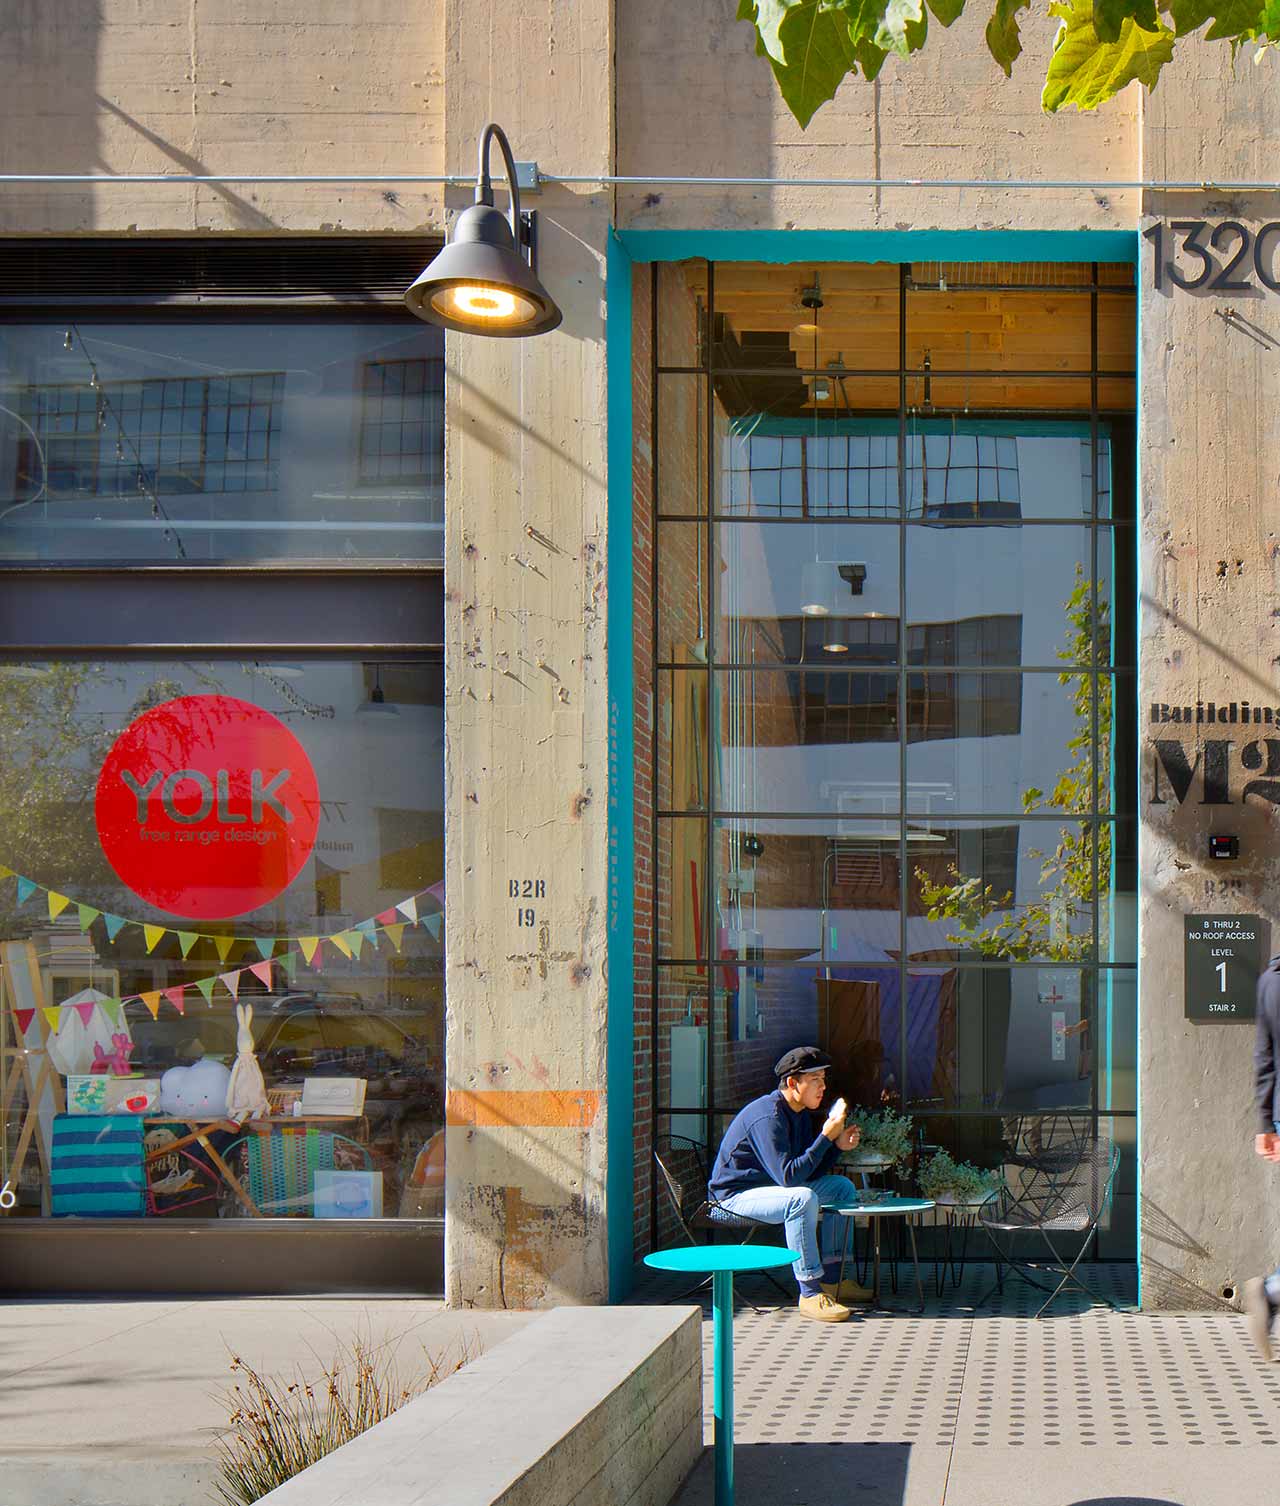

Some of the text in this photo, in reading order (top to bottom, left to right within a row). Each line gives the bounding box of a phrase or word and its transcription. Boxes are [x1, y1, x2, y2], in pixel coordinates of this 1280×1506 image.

[120, 768, 294, 826] YOLK
[138, 828, 278, 848] free range design
[508, 879, 547, 899] B2R
[517, 909, 536, 928] 19
[1189, 932, 1255, 940] NO ROOF ACCESS
[1215, 961, 1227, 992] 1
[1208, 1004, 1236, 1012] STAIR 2
[0, 1180, 16, 1209] 6
